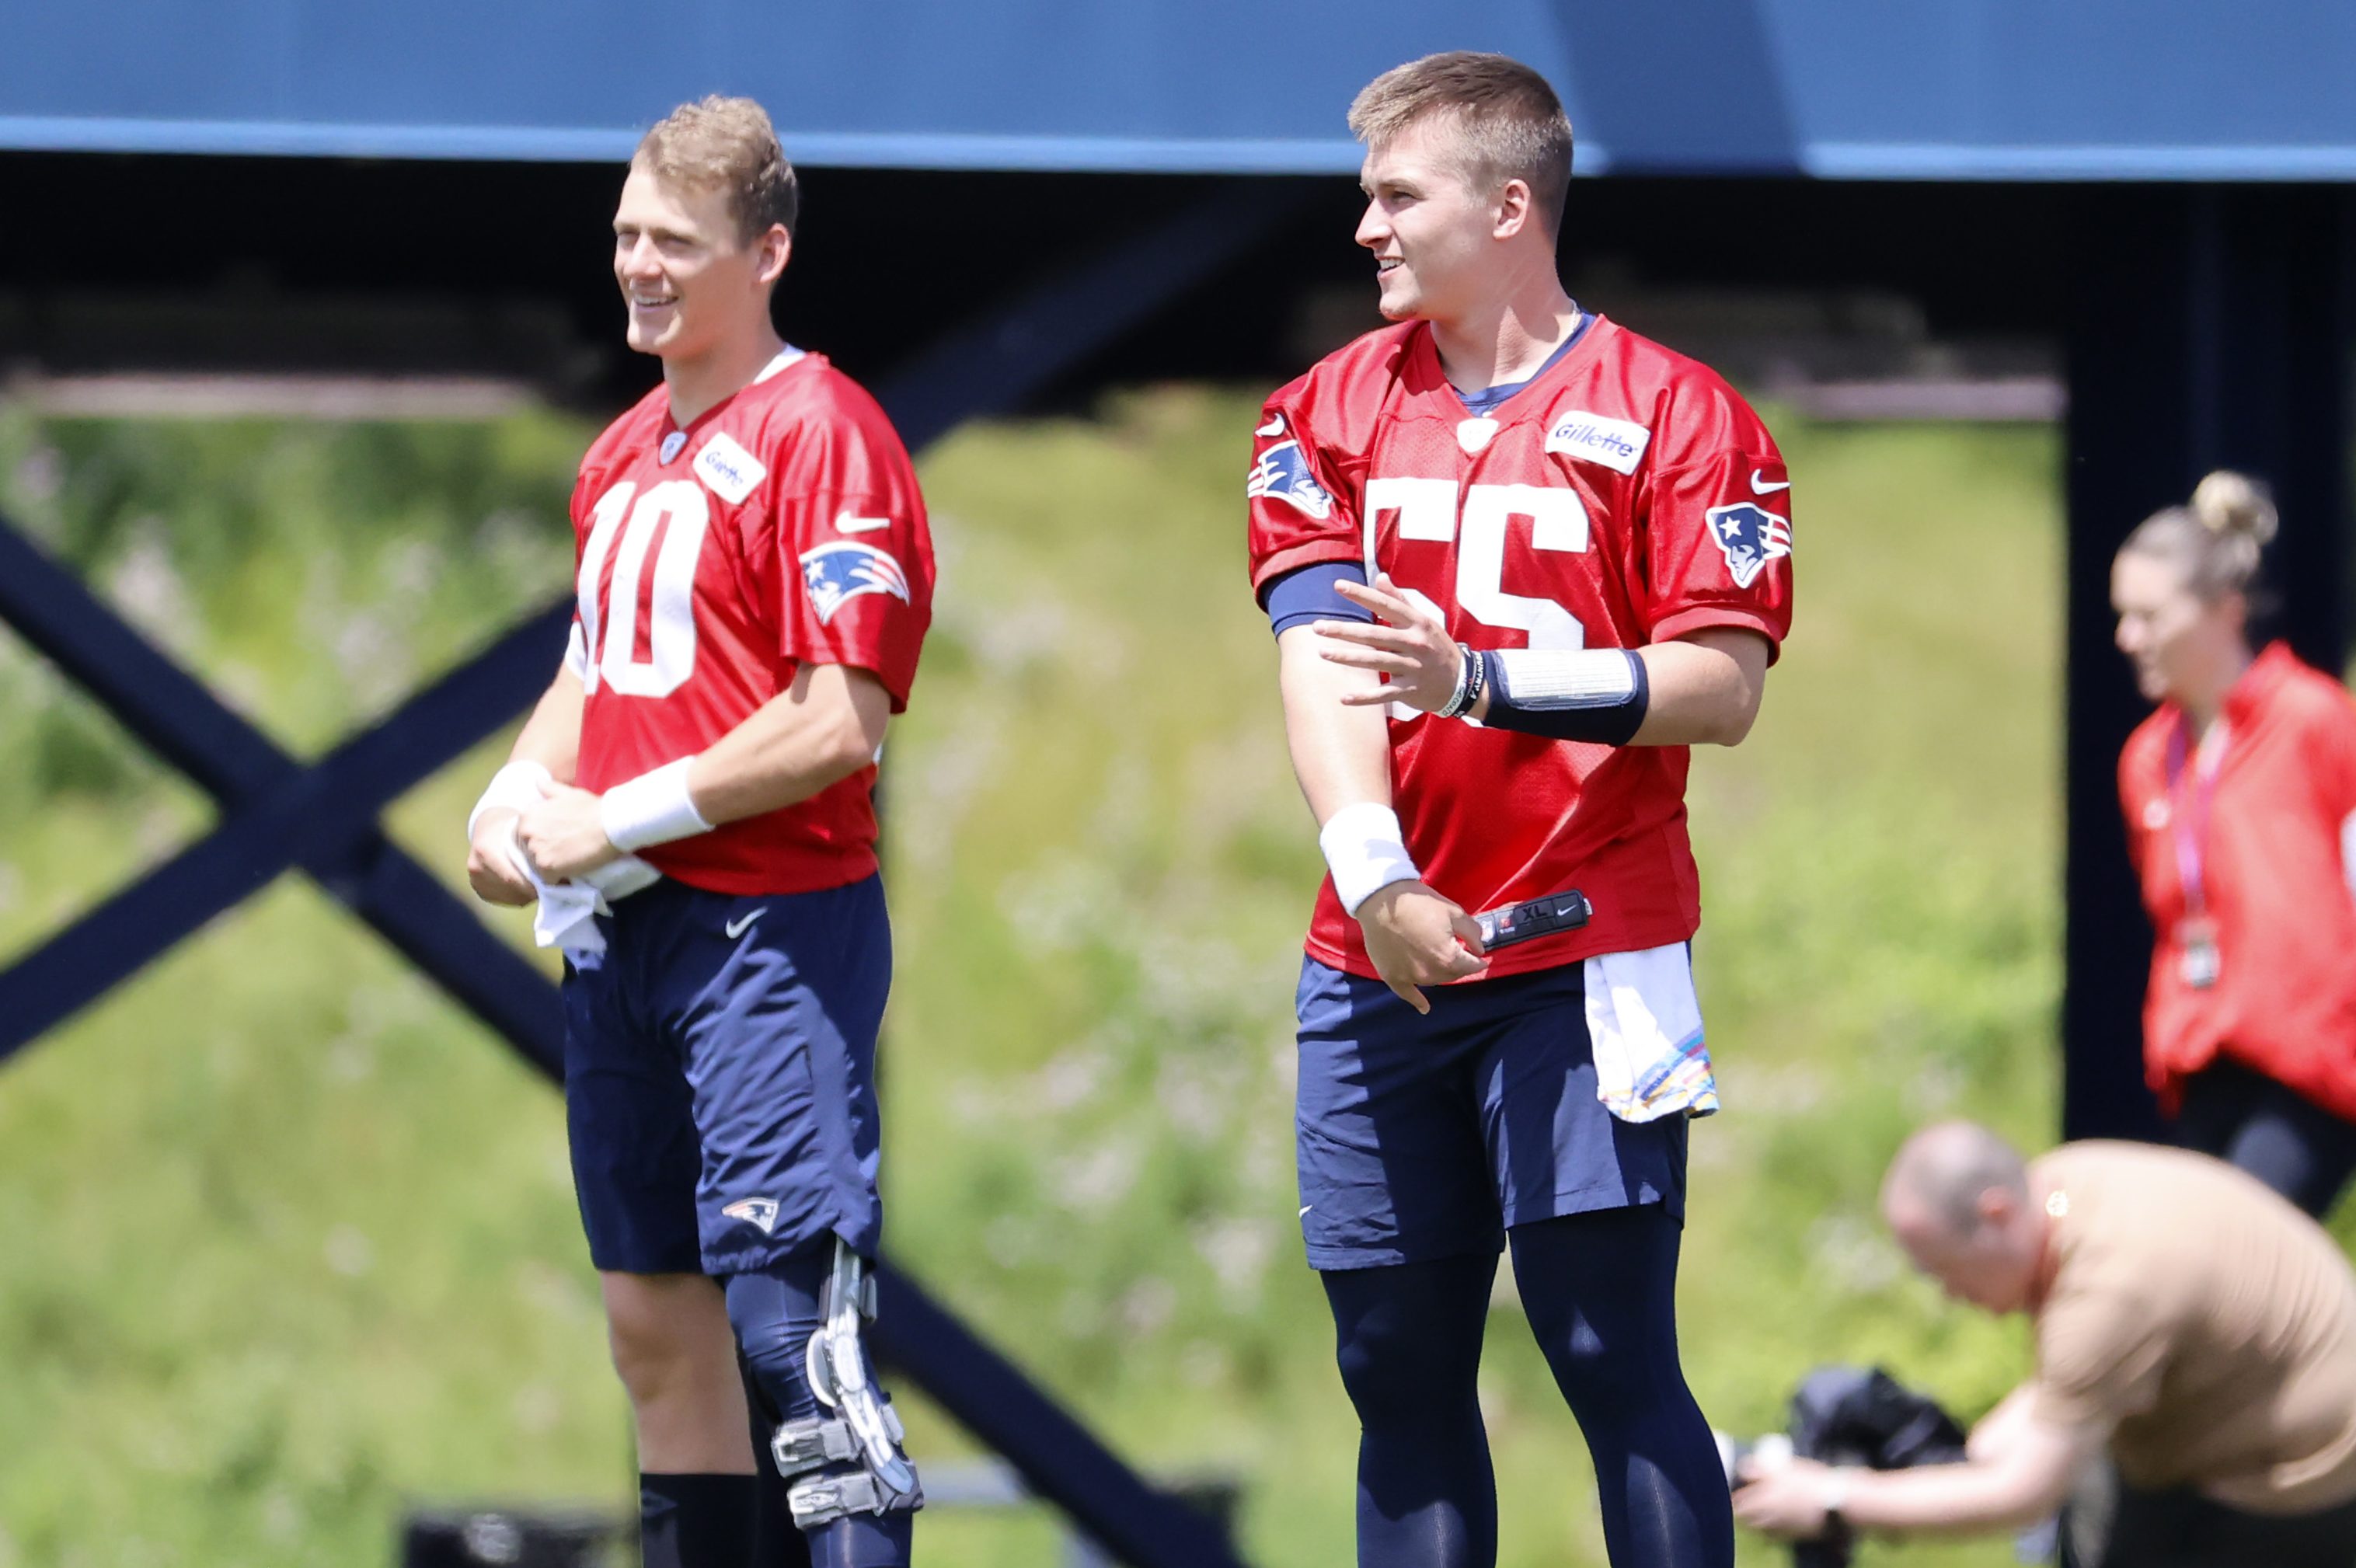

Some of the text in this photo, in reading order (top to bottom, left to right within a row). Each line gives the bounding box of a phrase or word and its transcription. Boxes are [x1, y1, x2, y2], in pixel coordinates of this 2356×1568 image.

[1555, 423, 1633, 457] Gillette
[577, 479, 710, 699] 10
[1522, 904, 1548, 922] XL
